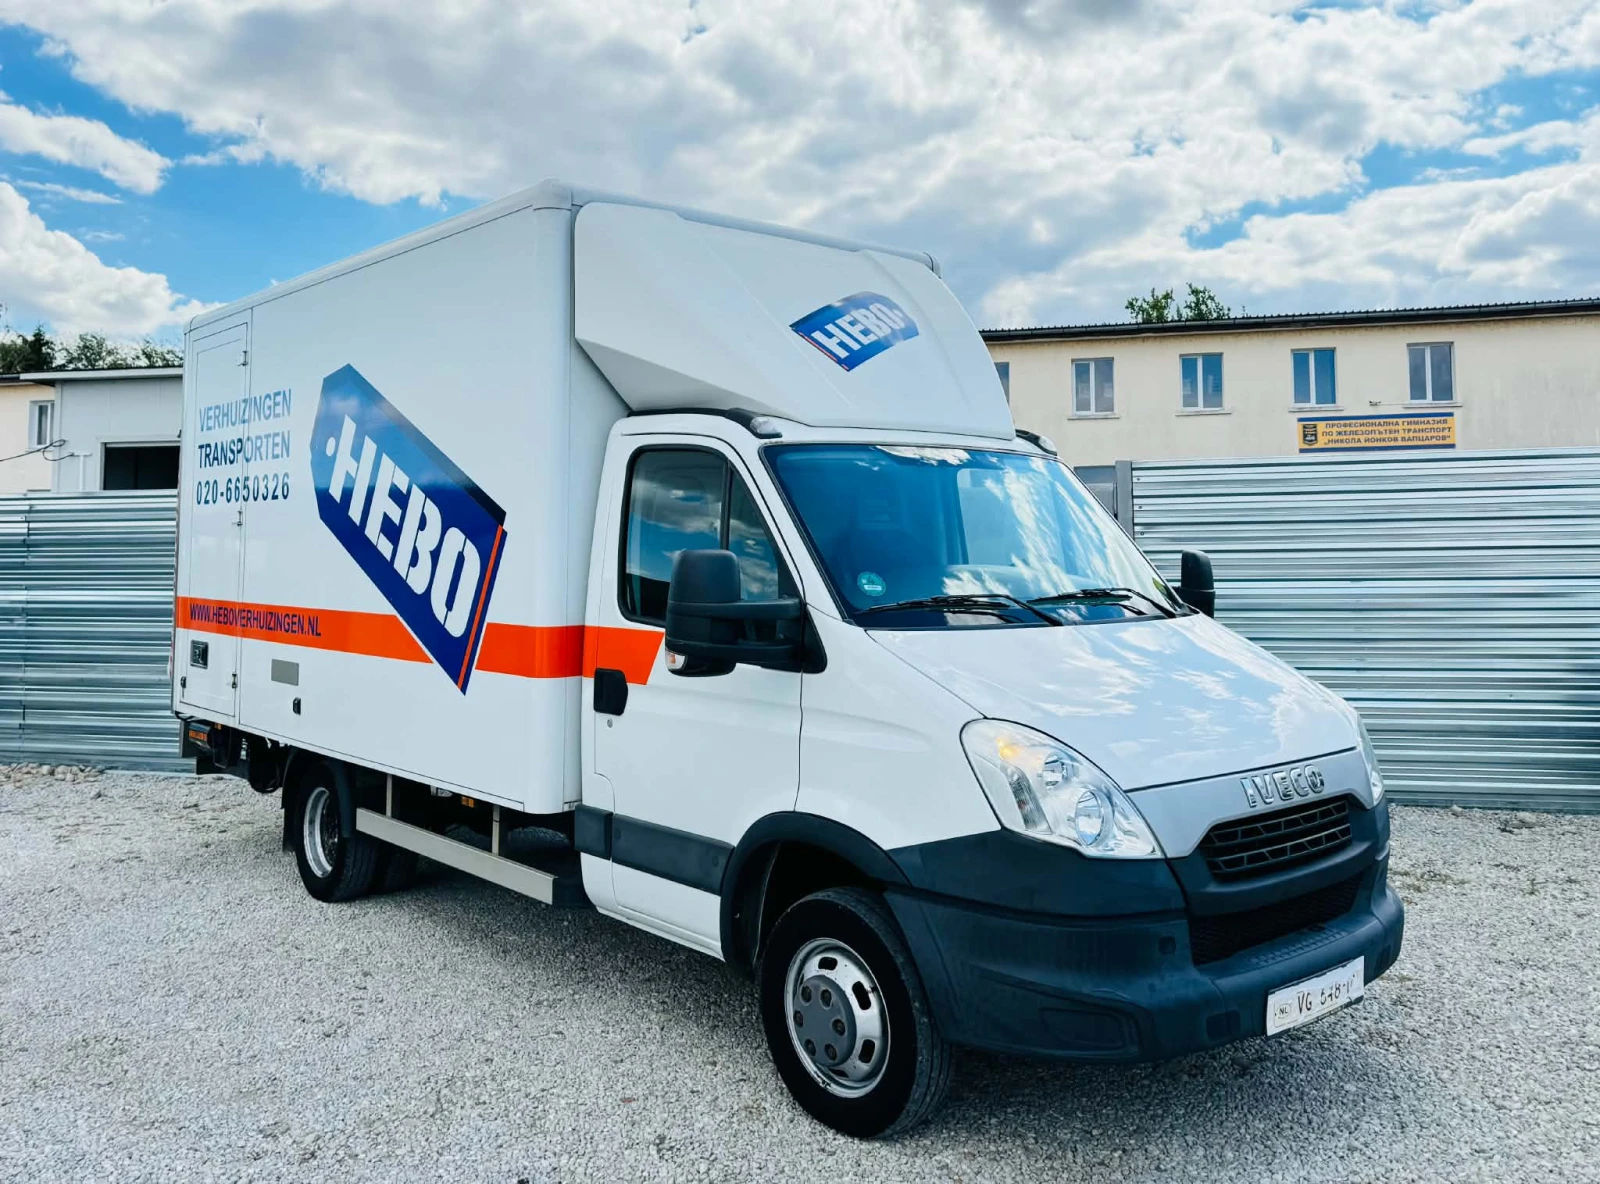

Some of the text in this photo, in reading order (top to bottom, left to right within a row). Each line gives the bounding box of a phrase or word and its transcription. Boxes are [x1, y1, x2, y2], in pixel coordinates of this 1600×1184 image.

[811, 303, 905, 359] HEBO
[199, 388, 292, 432] VERHUIZINGEN
[1402, 418, 1448, 426] ГИМНАЗИЯ
[198, 430, 291, 469] TRANSPORTEN
[1335, 428, 1400, 436] ЖЕЛЕЗОПЪТЕН
[1402, 426, 1452, 434] ТРАНСПОРТ
[196, 472, 290, 505] 020-6650326
[328, 413, 481, 638] HEBO
[189, 602, 322, 637] WWW.HEBOVERHUIZINGEN.NL
[1240, 764, 1325, 808] IVECO
[1297, 990, 1313, 1015] VG
